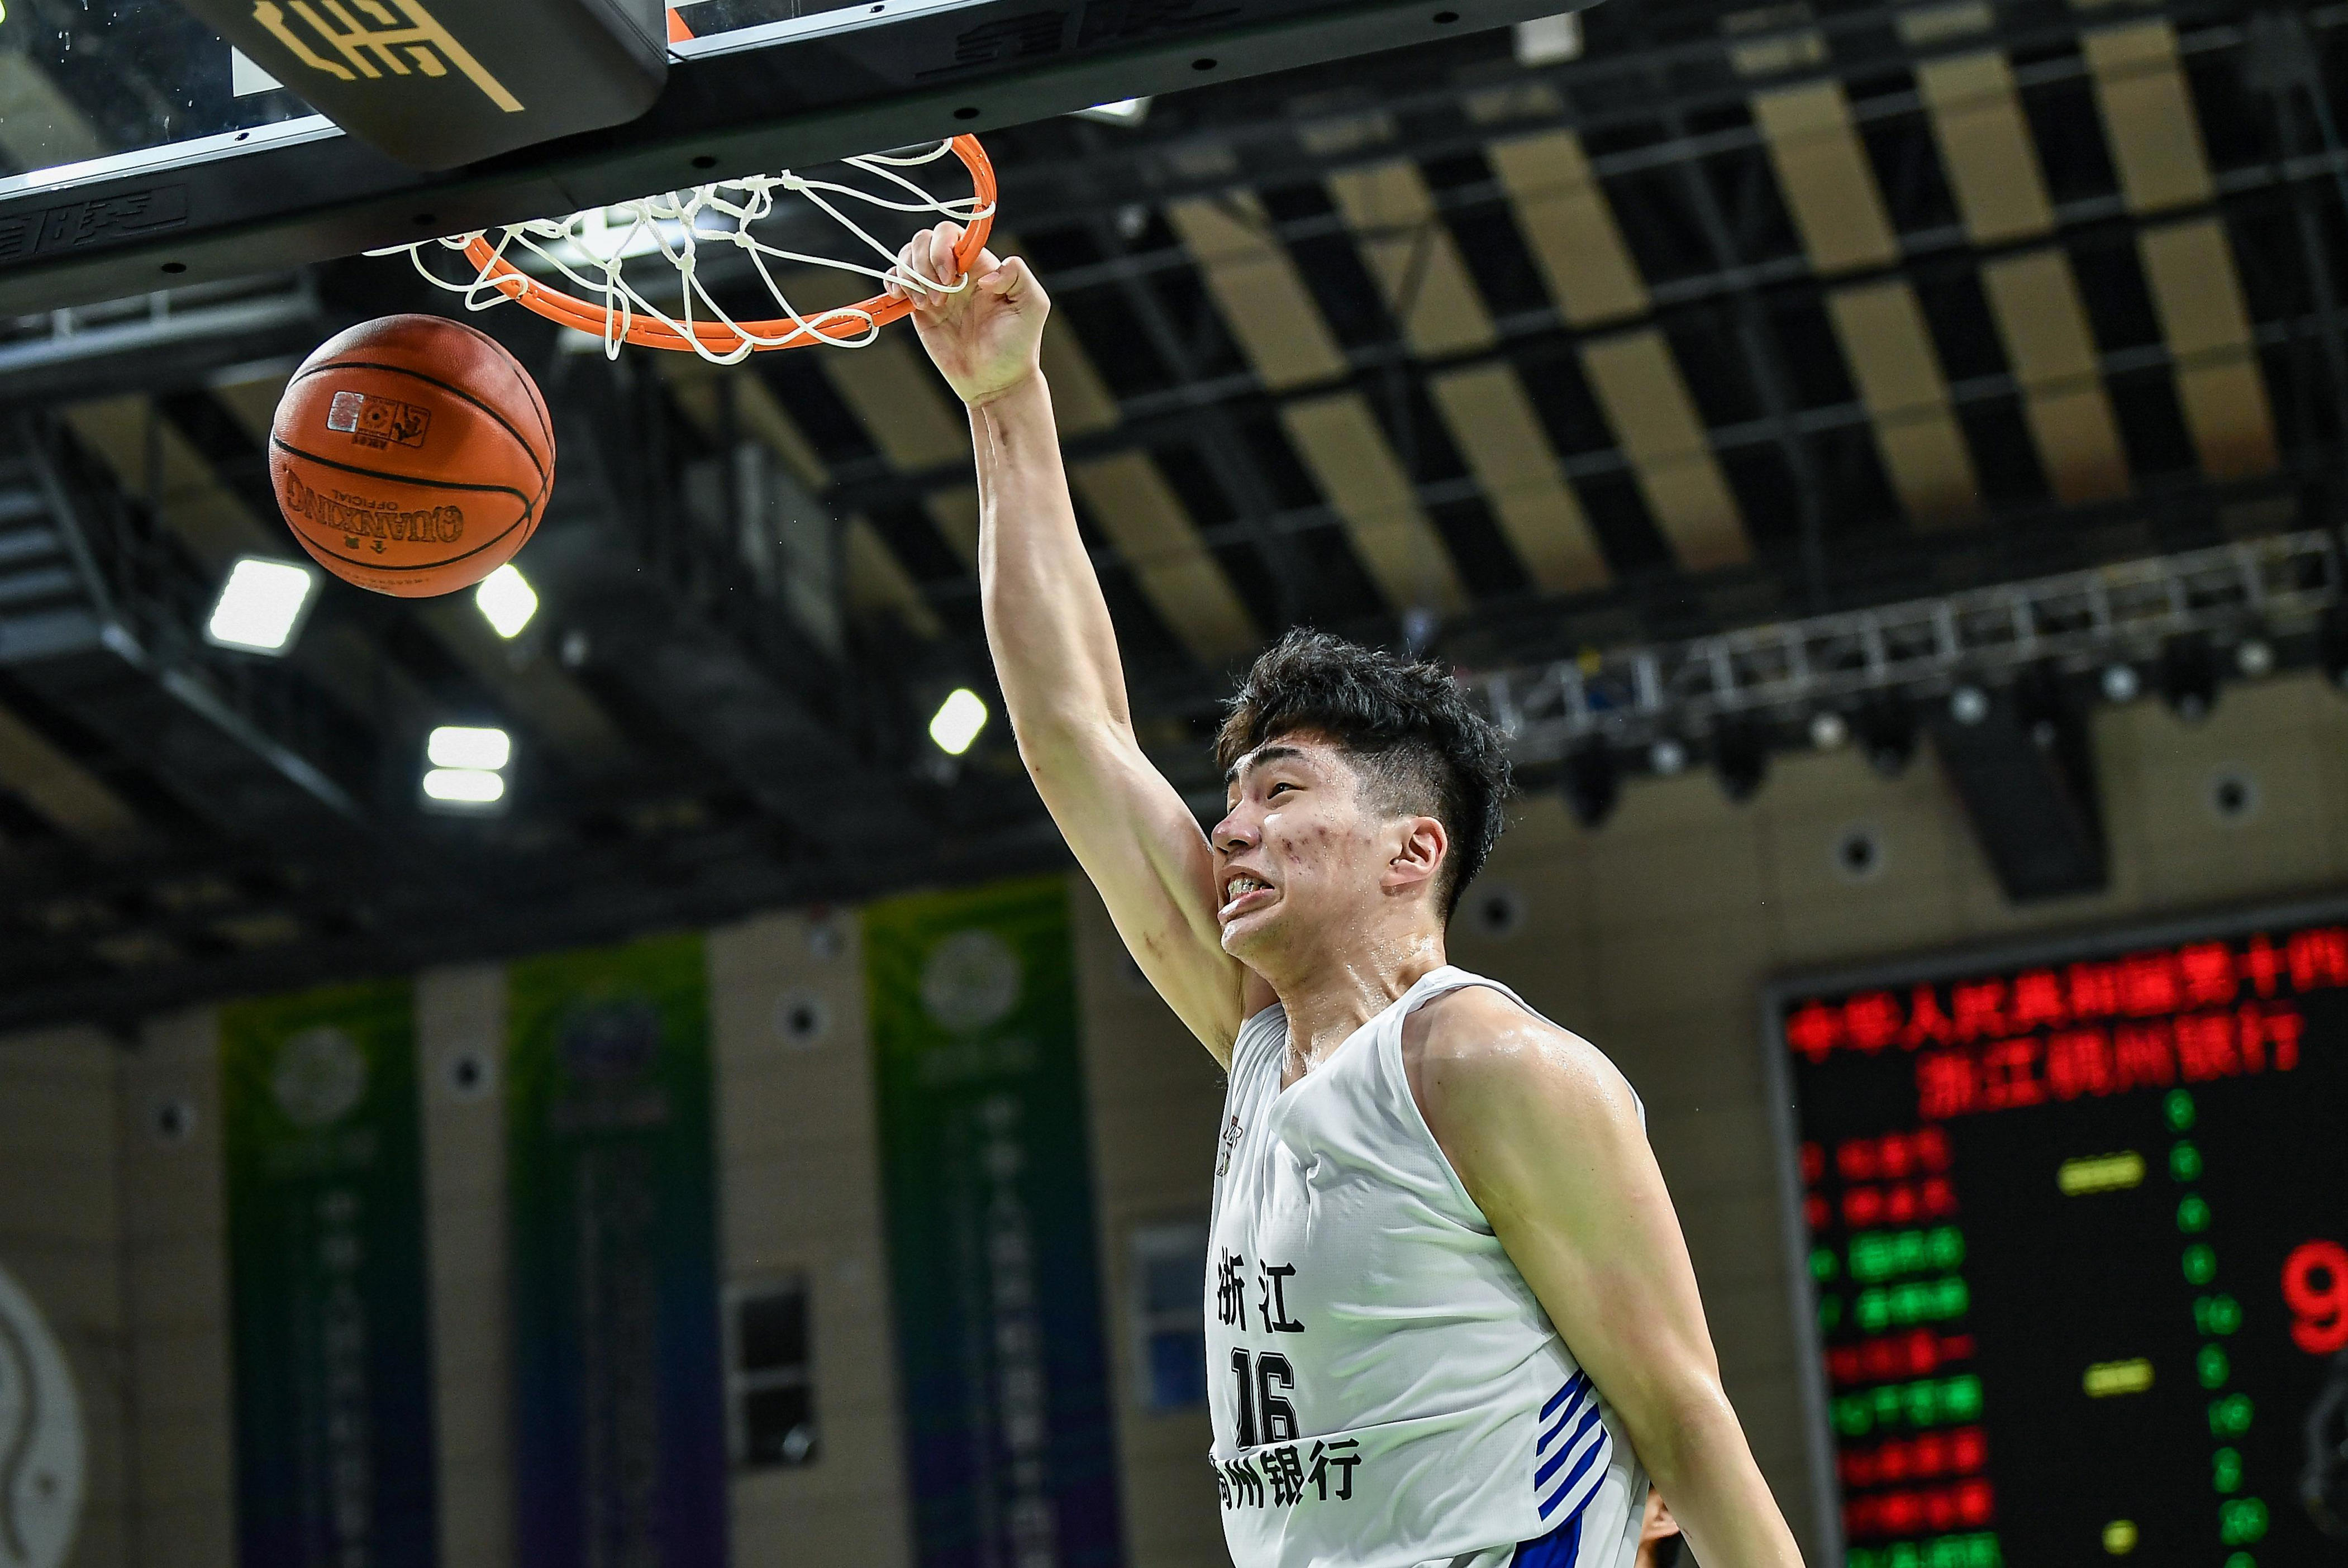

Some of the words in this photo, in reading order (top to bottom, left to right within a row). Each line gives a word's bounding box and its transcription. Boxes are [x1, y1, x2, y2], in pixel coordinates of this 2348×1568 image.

[285, 468, 464, 543] QUANXING
[332, 489, 398, 511] OFFICIAL
[1217, 1250, 1306, 1333] 浙江
[1231, 1346, 1302, 1453] 16
